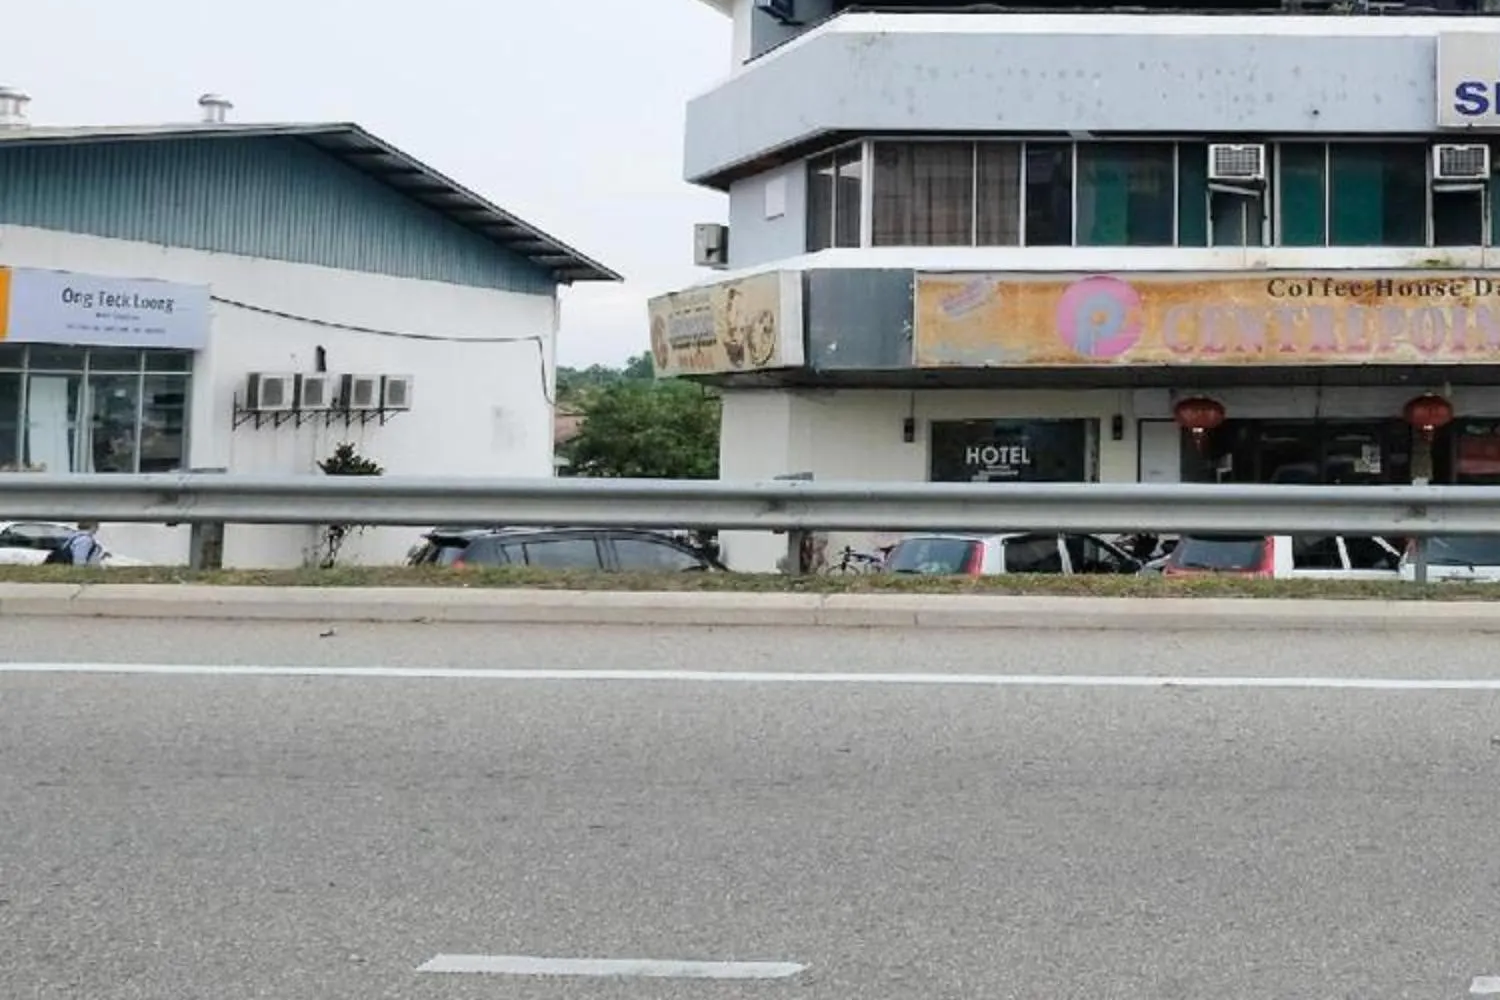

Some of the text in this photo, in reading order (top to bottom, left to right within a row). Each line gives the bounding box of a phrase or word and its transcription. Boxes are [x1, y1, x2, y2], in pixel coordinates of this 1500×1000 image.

[61, 287, 92, 308] Ong
[1267, 277, 1364, 298] Coffee
[1374, 277, 1464, 298] House
[966, 446, 1031, 465] HOTEL
